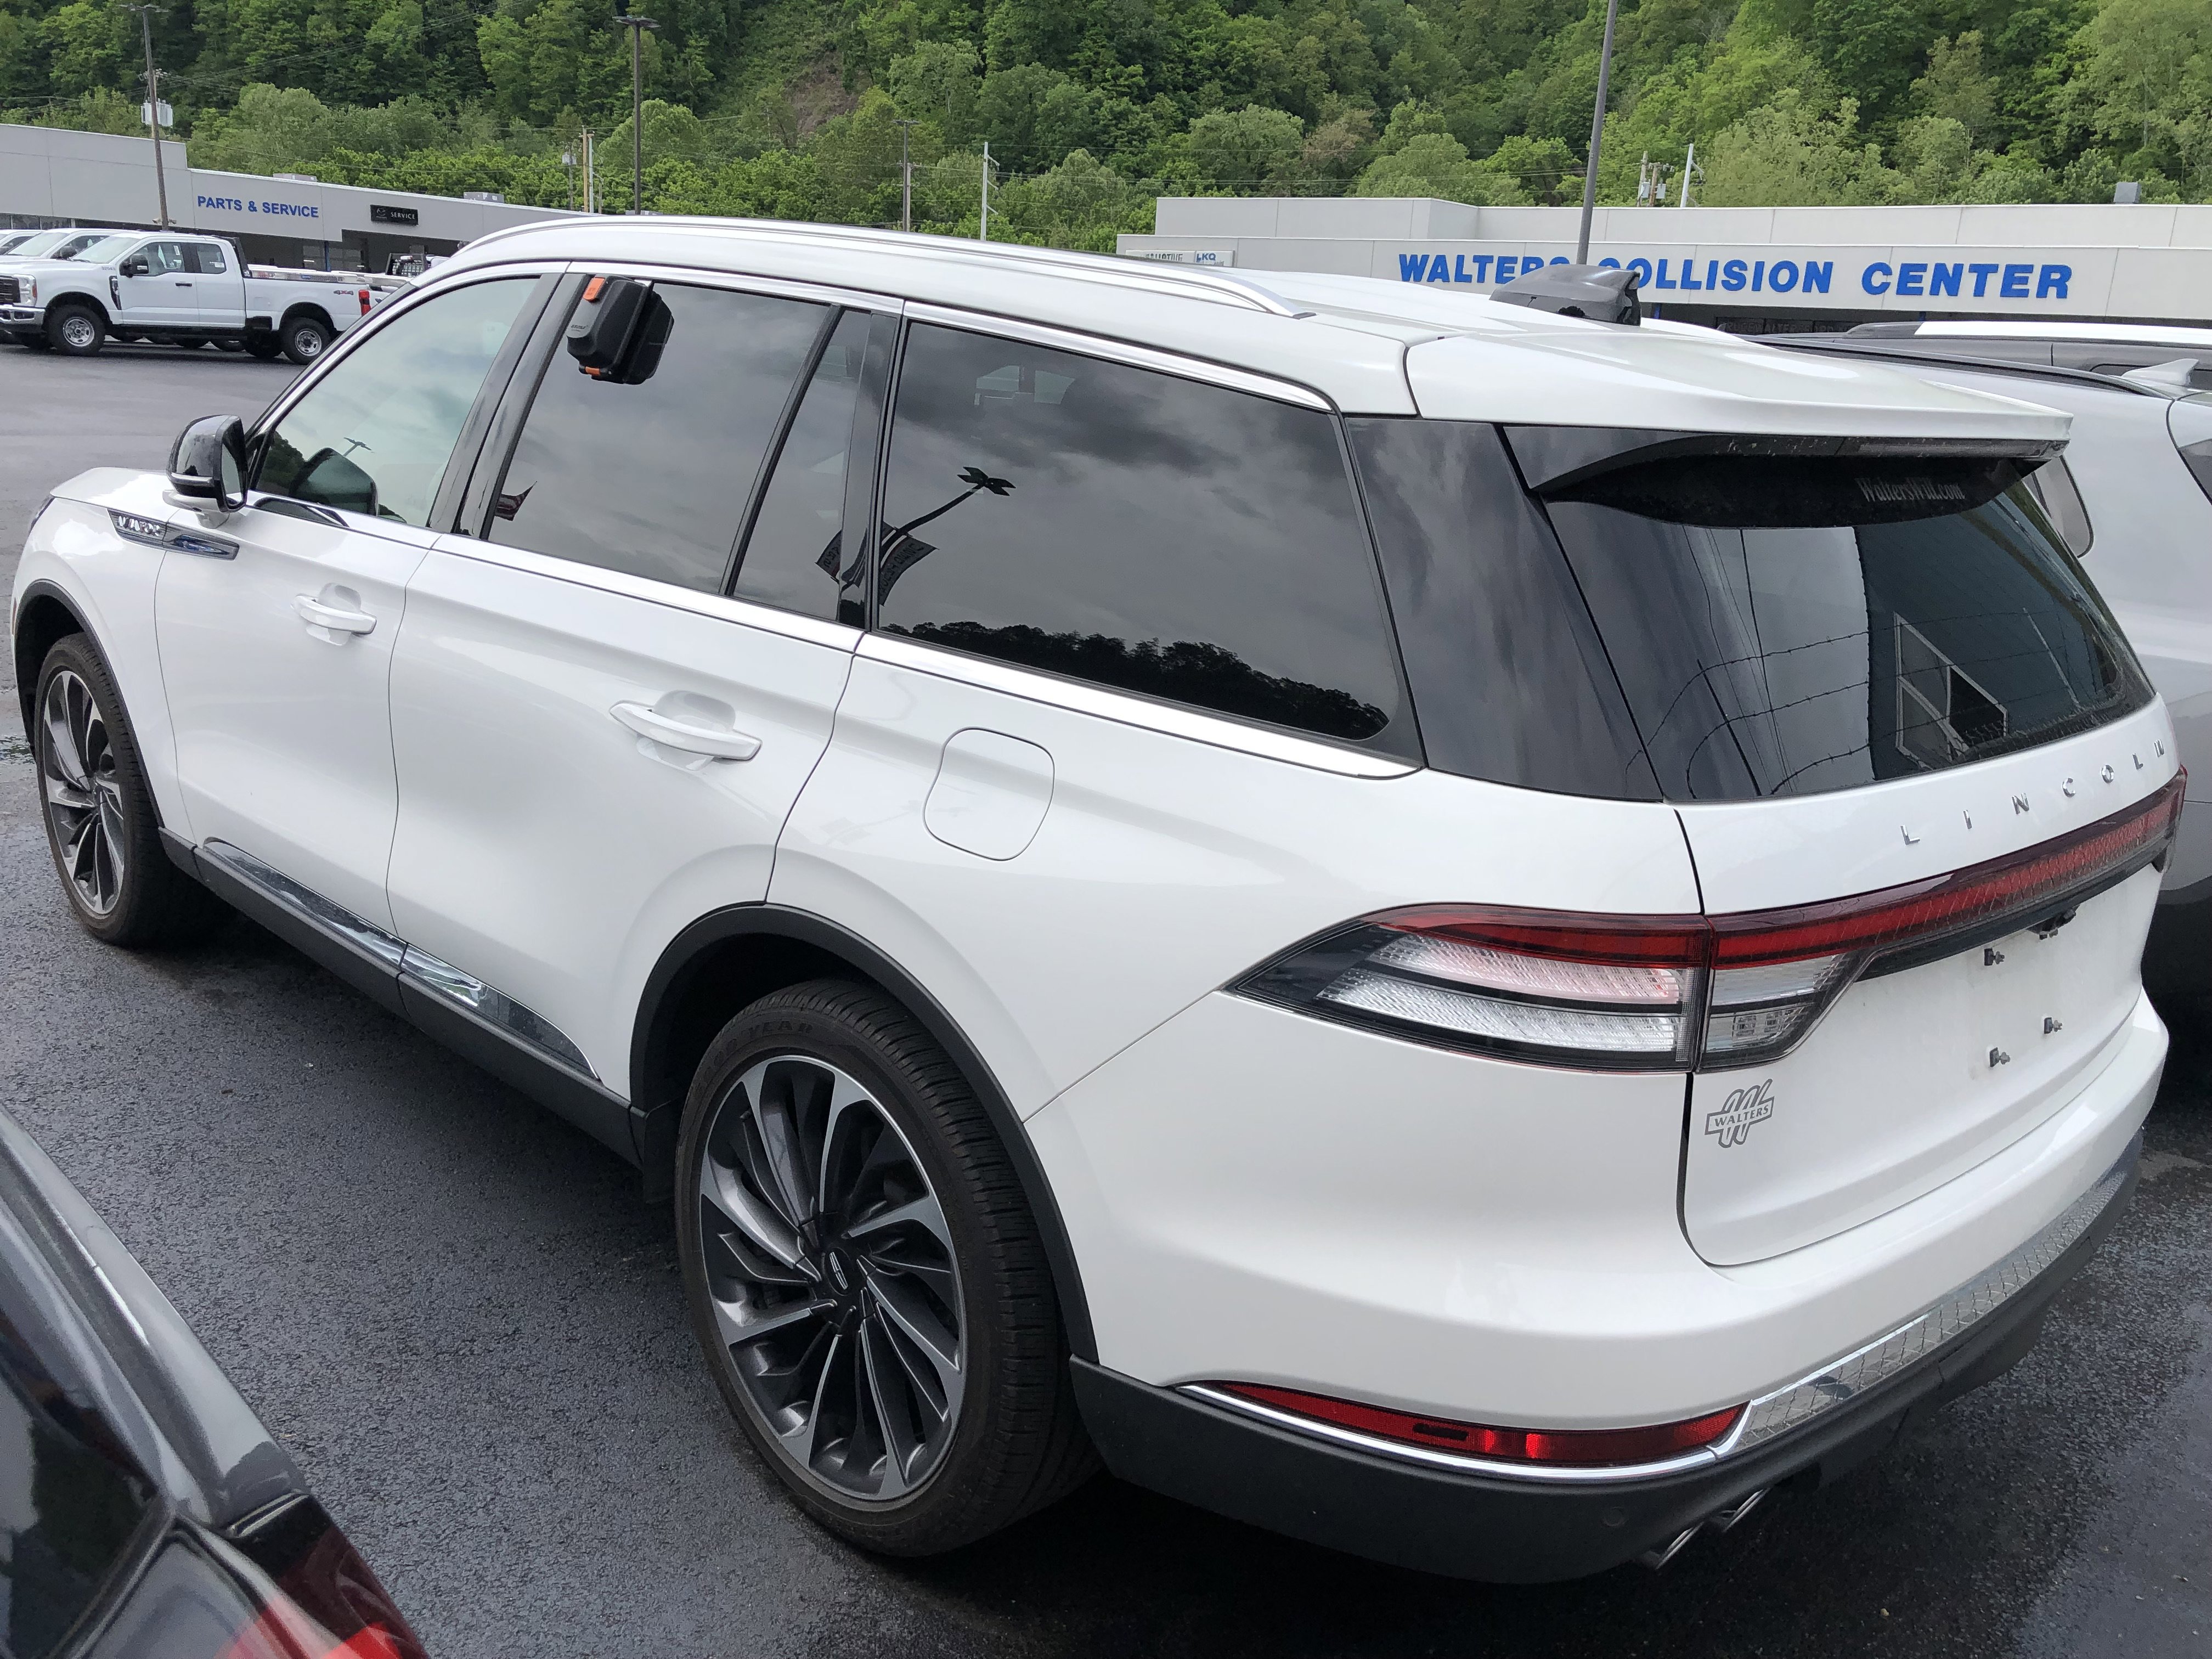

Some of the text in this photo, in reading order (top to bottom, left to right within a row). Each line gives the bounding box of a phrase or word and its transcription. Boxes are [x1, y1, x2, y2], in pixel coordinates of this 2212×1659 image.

[198, 195, 319, 218] PARTS & SERVICE
[1196, 253, 1216, 262] LKQ
[1861, 262, 2073, 300] CENTER
[1900, 738, 2165, 845] LINCOLN
[1714, 1104, 1769, 1127] WALTERS
